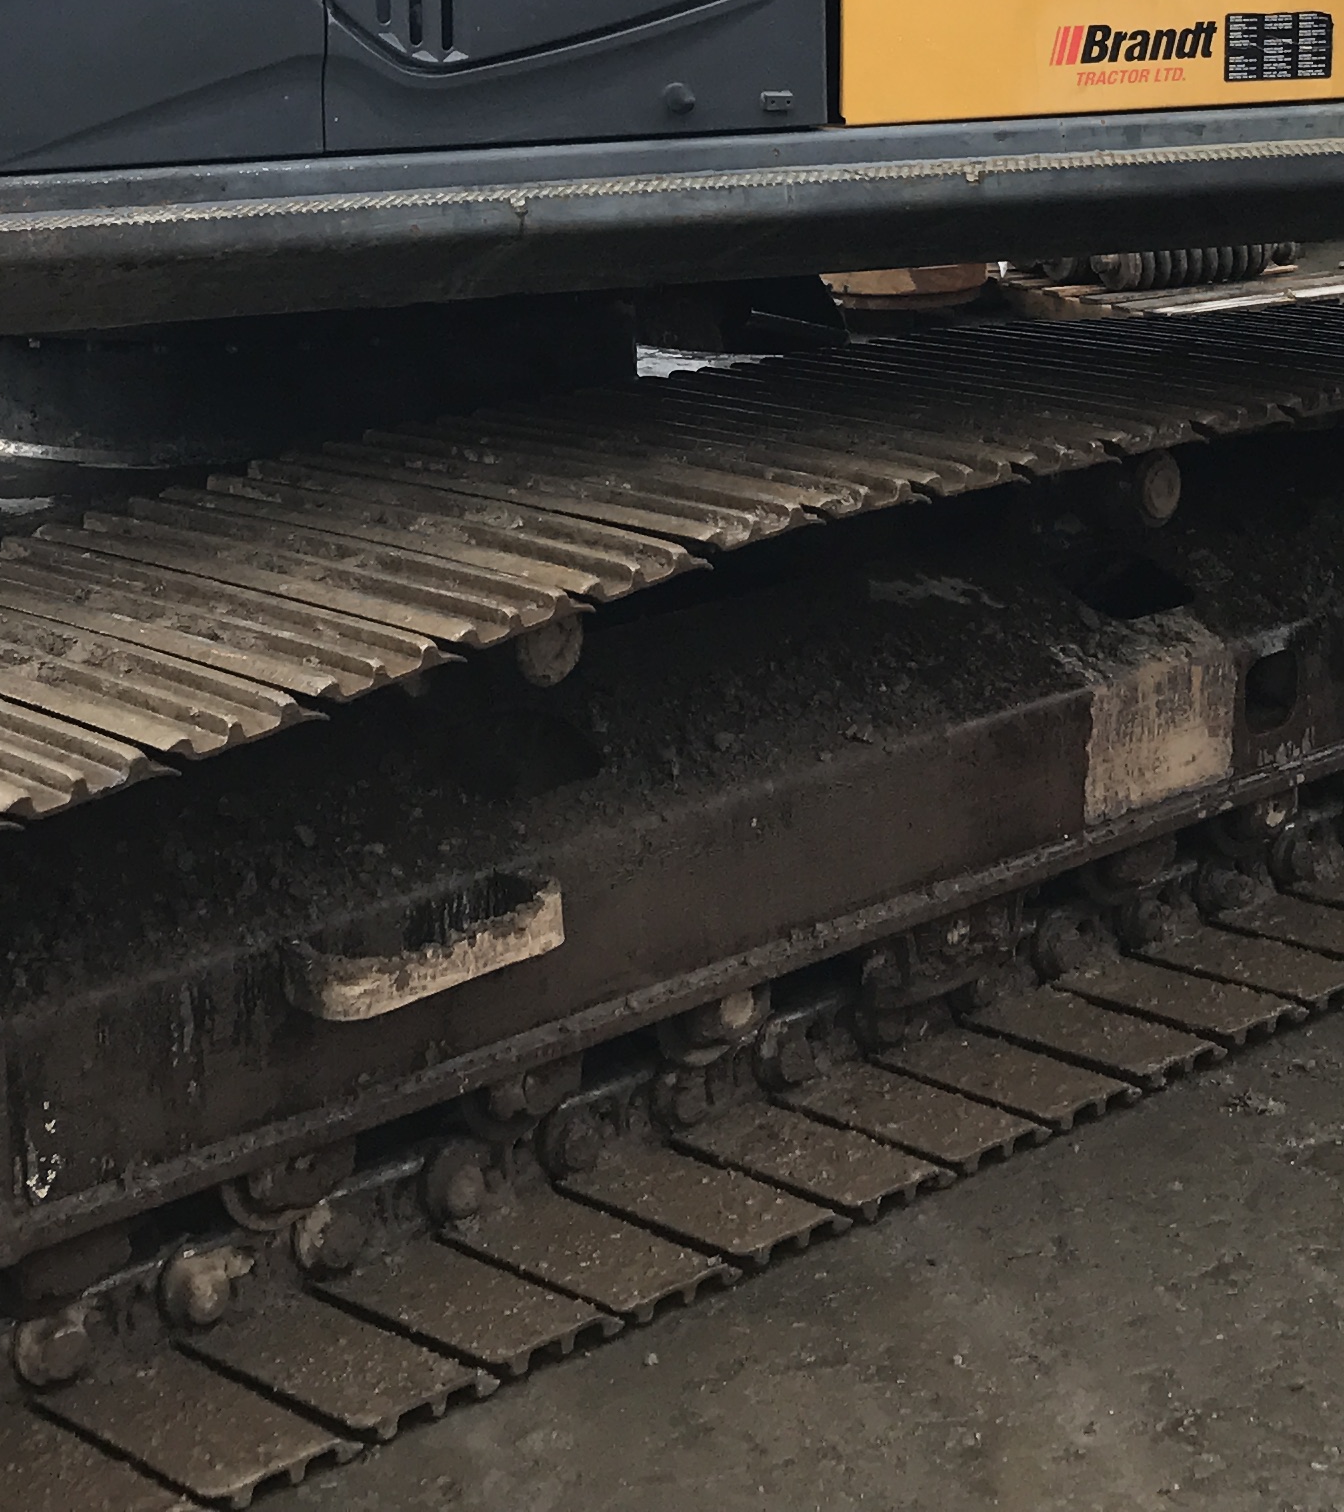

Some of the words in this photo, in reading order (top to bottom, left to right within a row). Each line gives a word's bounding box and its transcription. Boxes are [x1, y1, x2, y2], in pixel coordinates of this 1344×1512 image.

[1080, 21, 1217, 64] Brandt
[1076, 68, 1150, 87] TRACTOR
[1153, 66, 1187, 83] LTD.
